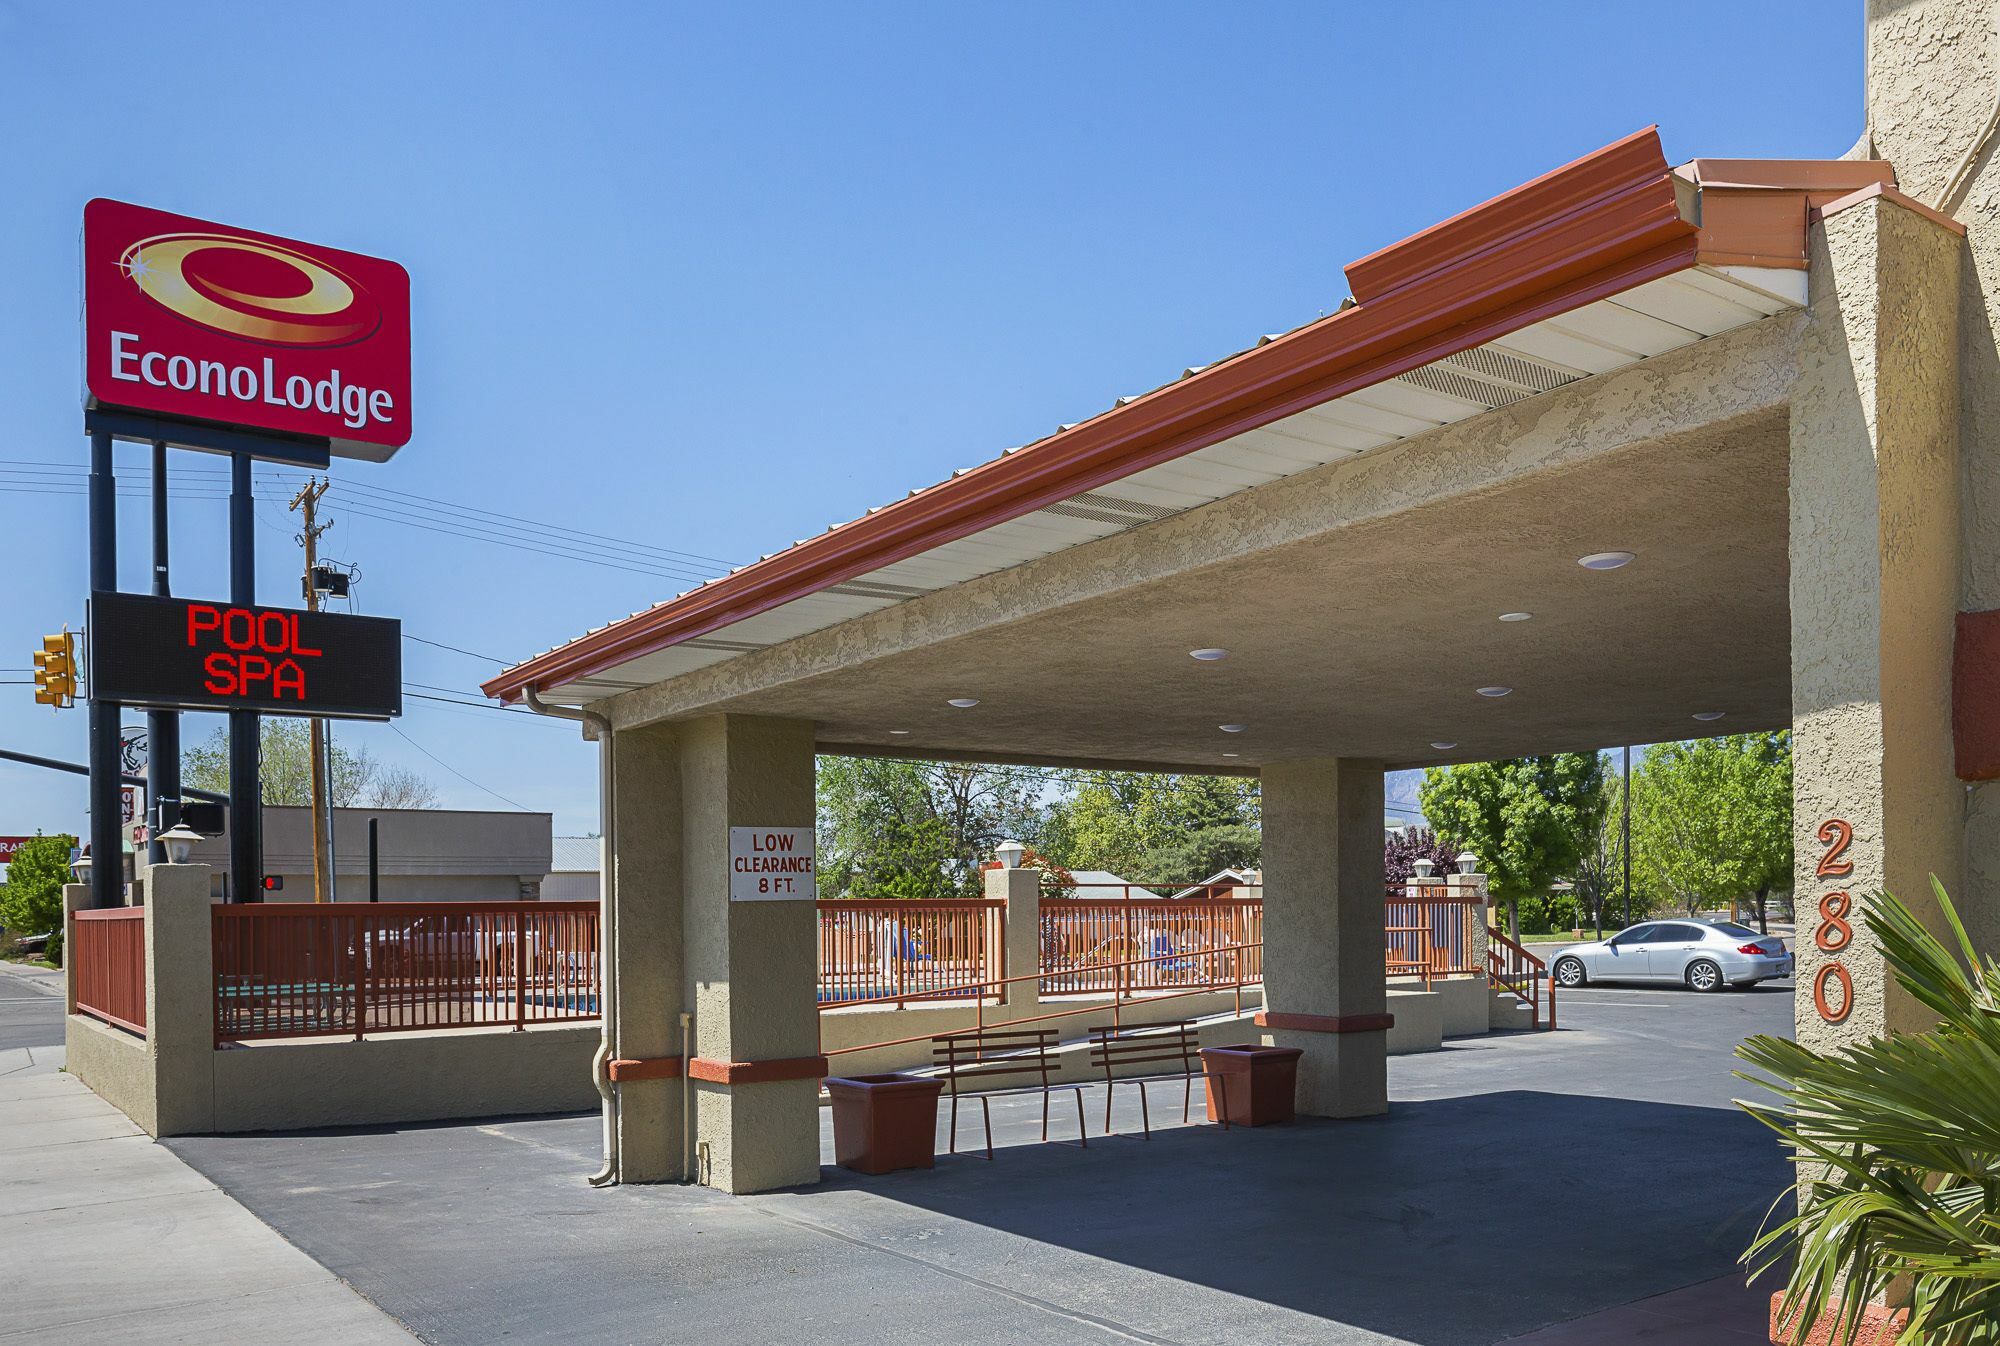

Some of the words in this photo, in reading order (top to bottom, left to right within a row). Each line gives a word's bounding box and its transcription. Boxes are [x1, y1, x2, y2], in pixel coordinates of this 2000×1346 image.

[111, 330, 393, 428] EconoLodge
[188, 604, 322, 656] POOL
[204, 652, 304, 699] SPA
[735, 857, 811, 873] CLEARANCE
[753, 834, 794, 851] LOW
[758, 878, 769, 893] 8
[774, 878, 796, 893] FT.
[1814, 818, 1853, 1022] 280
